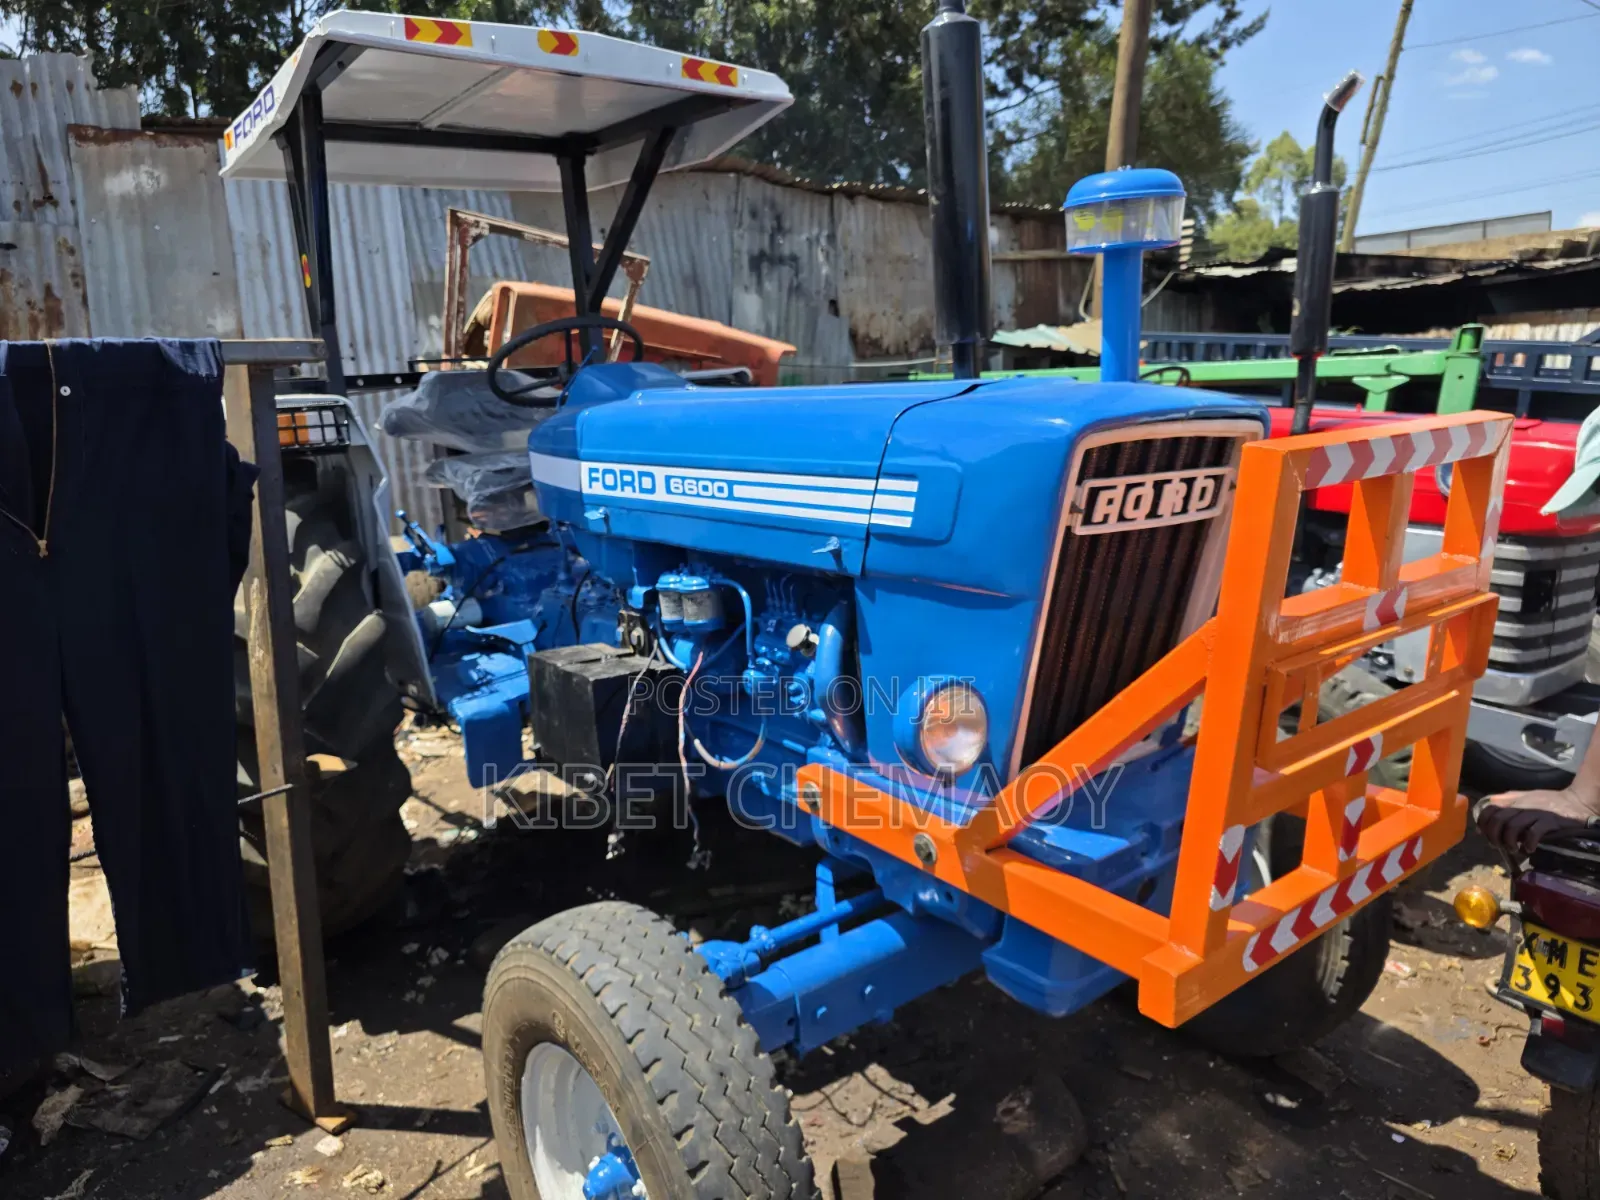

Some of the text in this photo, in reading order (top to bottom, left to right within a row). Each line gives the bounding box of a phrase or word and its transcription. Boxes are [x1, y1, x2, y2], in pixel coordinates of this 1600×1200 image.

[233, 85, 275, 148] FORD
[588, 467, 729, 498] FORD 6600
[1515, 964, 1593, 1012] 393
